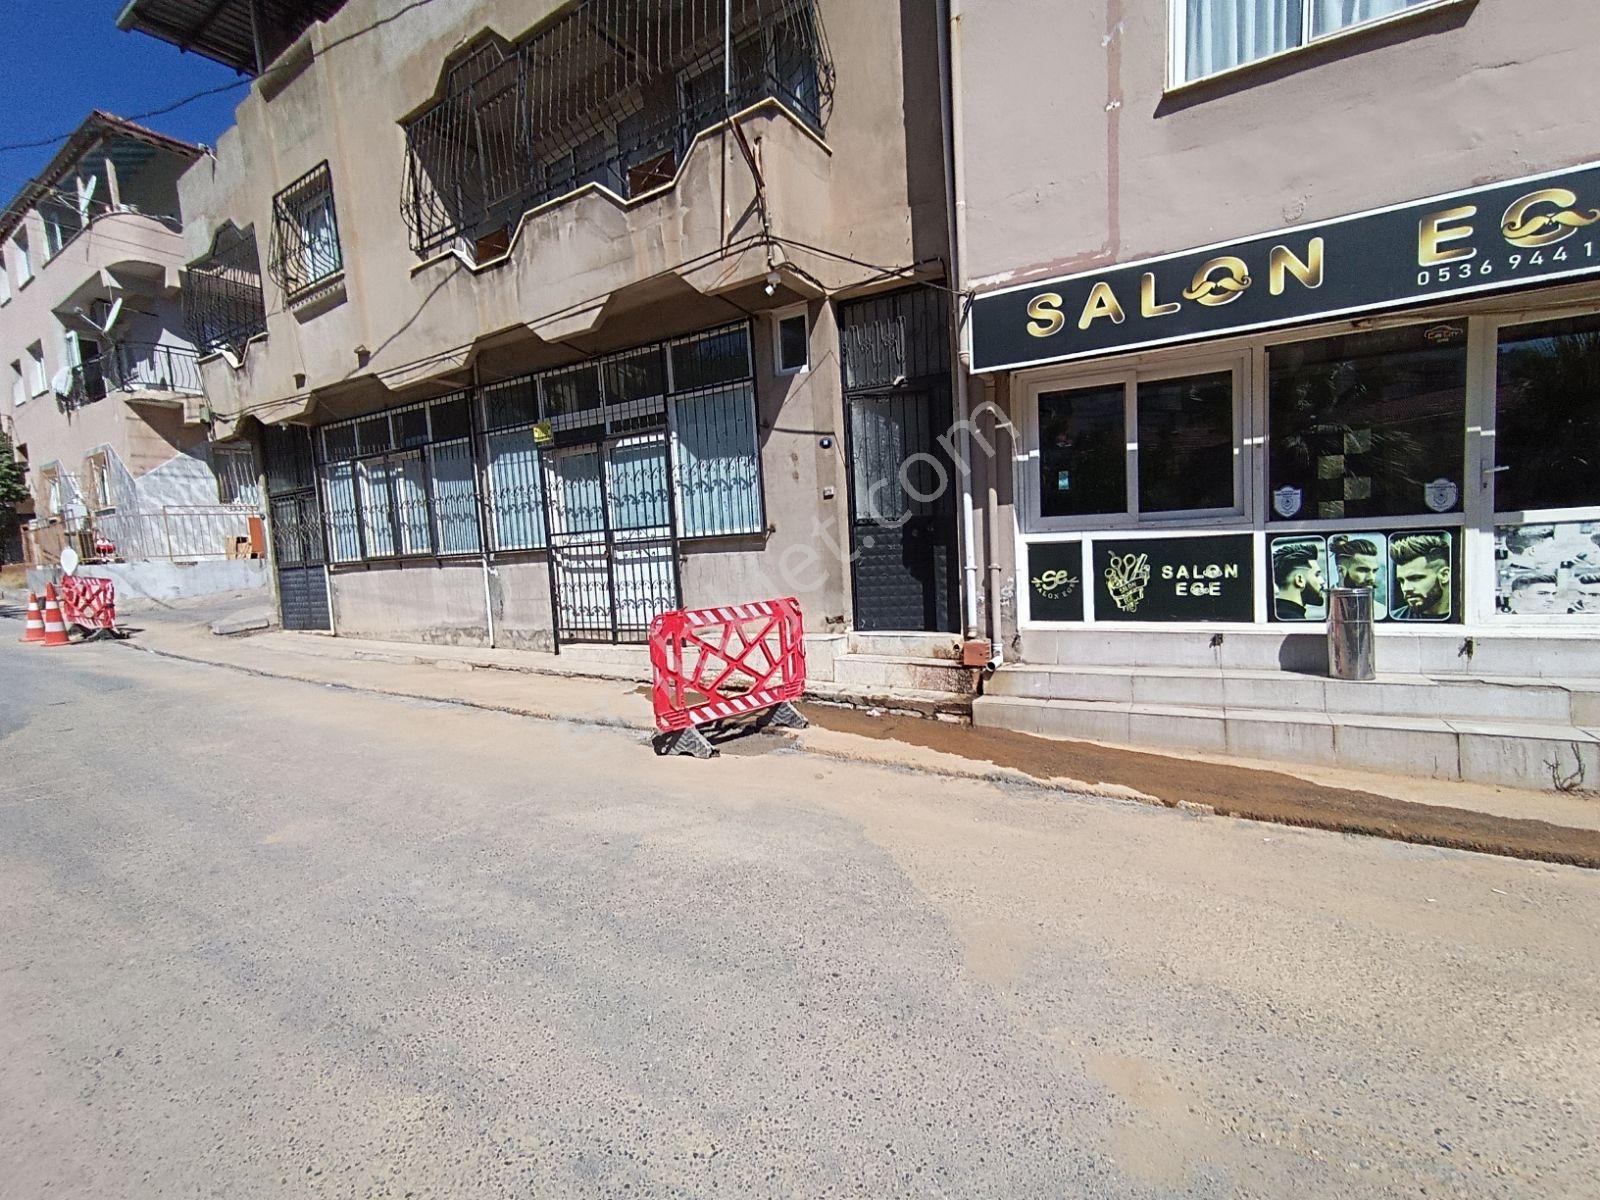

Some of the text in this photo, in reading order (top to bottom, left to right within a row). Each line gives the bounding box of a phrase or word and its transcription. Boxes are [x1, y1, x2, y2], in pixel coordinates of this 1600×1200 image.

[1417, 260, 1492, 285] 0536
[1509, 246, 1567, 269] 944
[1026, 236, 1324, 337] SALON
[1161, 564, 1238, 579] SALON
[1175, 581, 1221, 596] EGE
